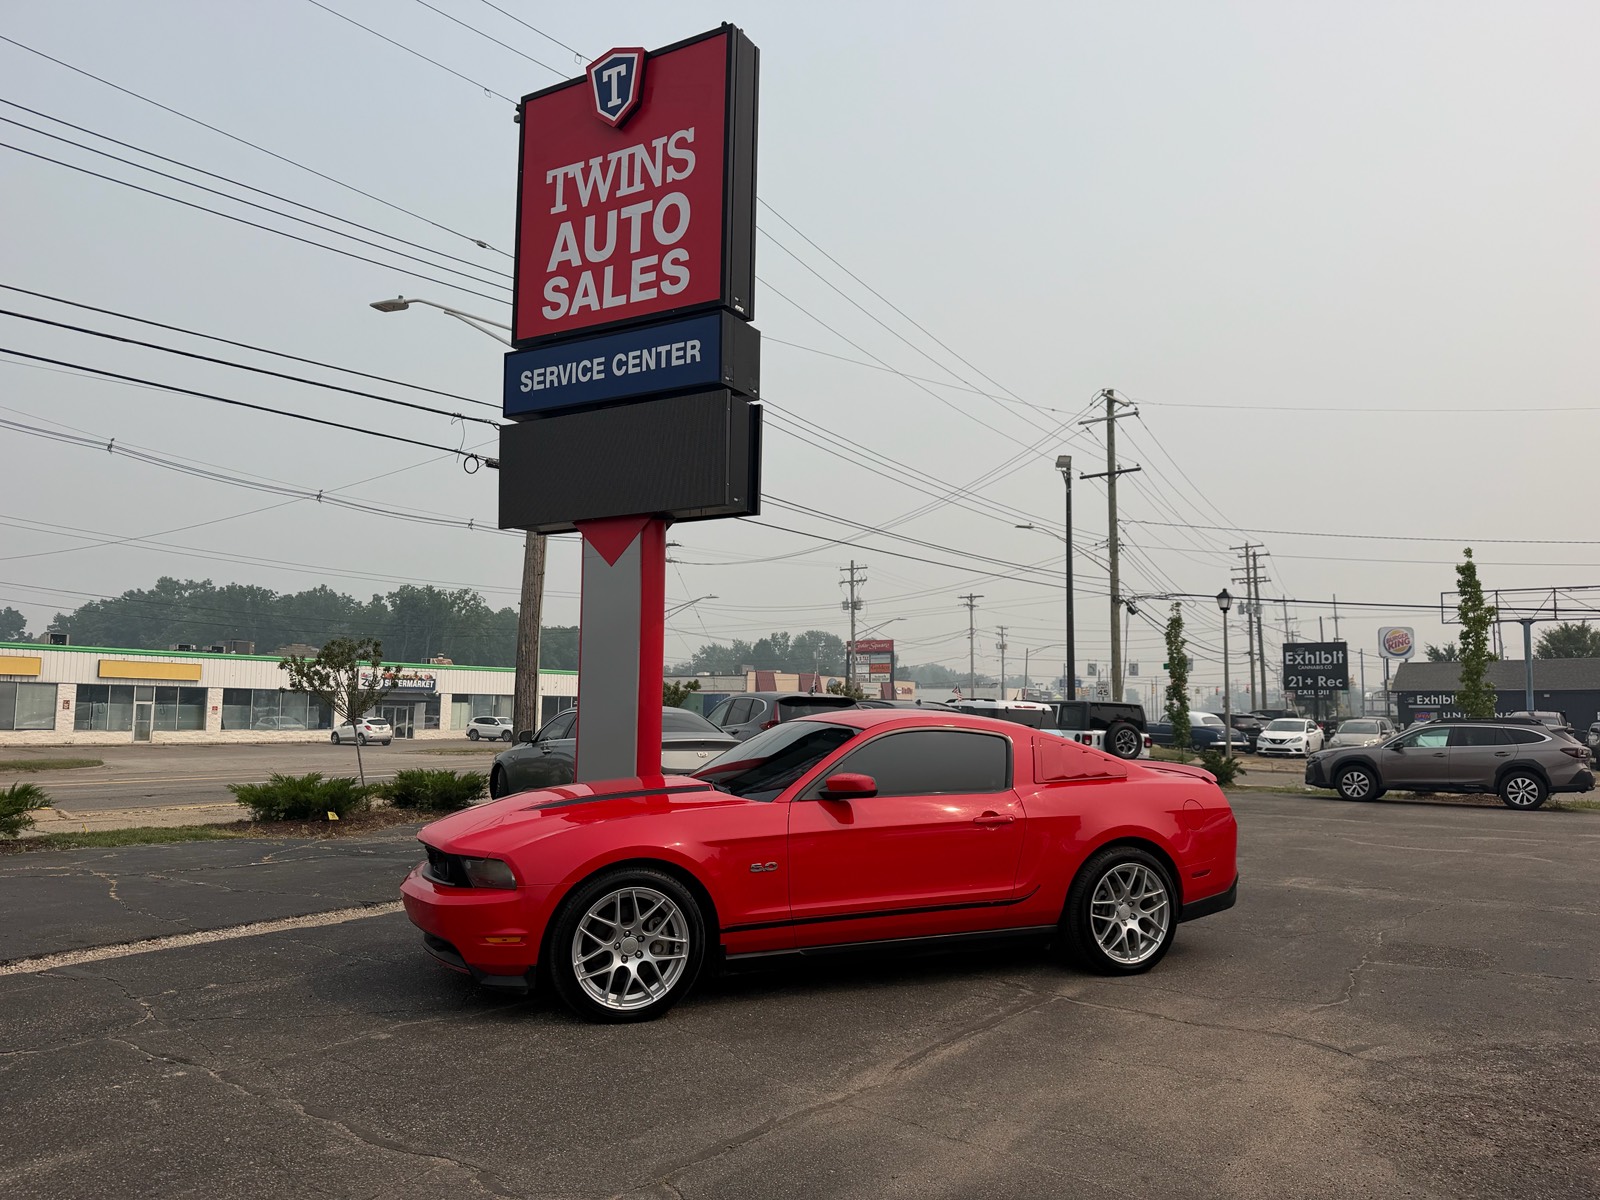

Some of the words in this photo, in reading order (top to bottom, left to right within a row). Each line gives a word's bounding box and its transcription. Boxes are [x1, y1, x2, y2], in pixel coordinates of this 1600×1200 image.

[602, 64, 626, 108] T
[546, 127, 696, 214] TWINS
[546, 191, 691, 273] AUTO
[541, 247, 690, 320] SALES
[520, 357, 605, 393] SERVICE
[612, 339, 701, 376] CENTER
[1285, 650, 1344, 664] Exhibit
[1388, 637, 1411, 650] KING
[384, 680, 435, 688] SERMARKET
[1317, 675, 1343, 687] Rec
[750, 861, 778, 872] 5.0
